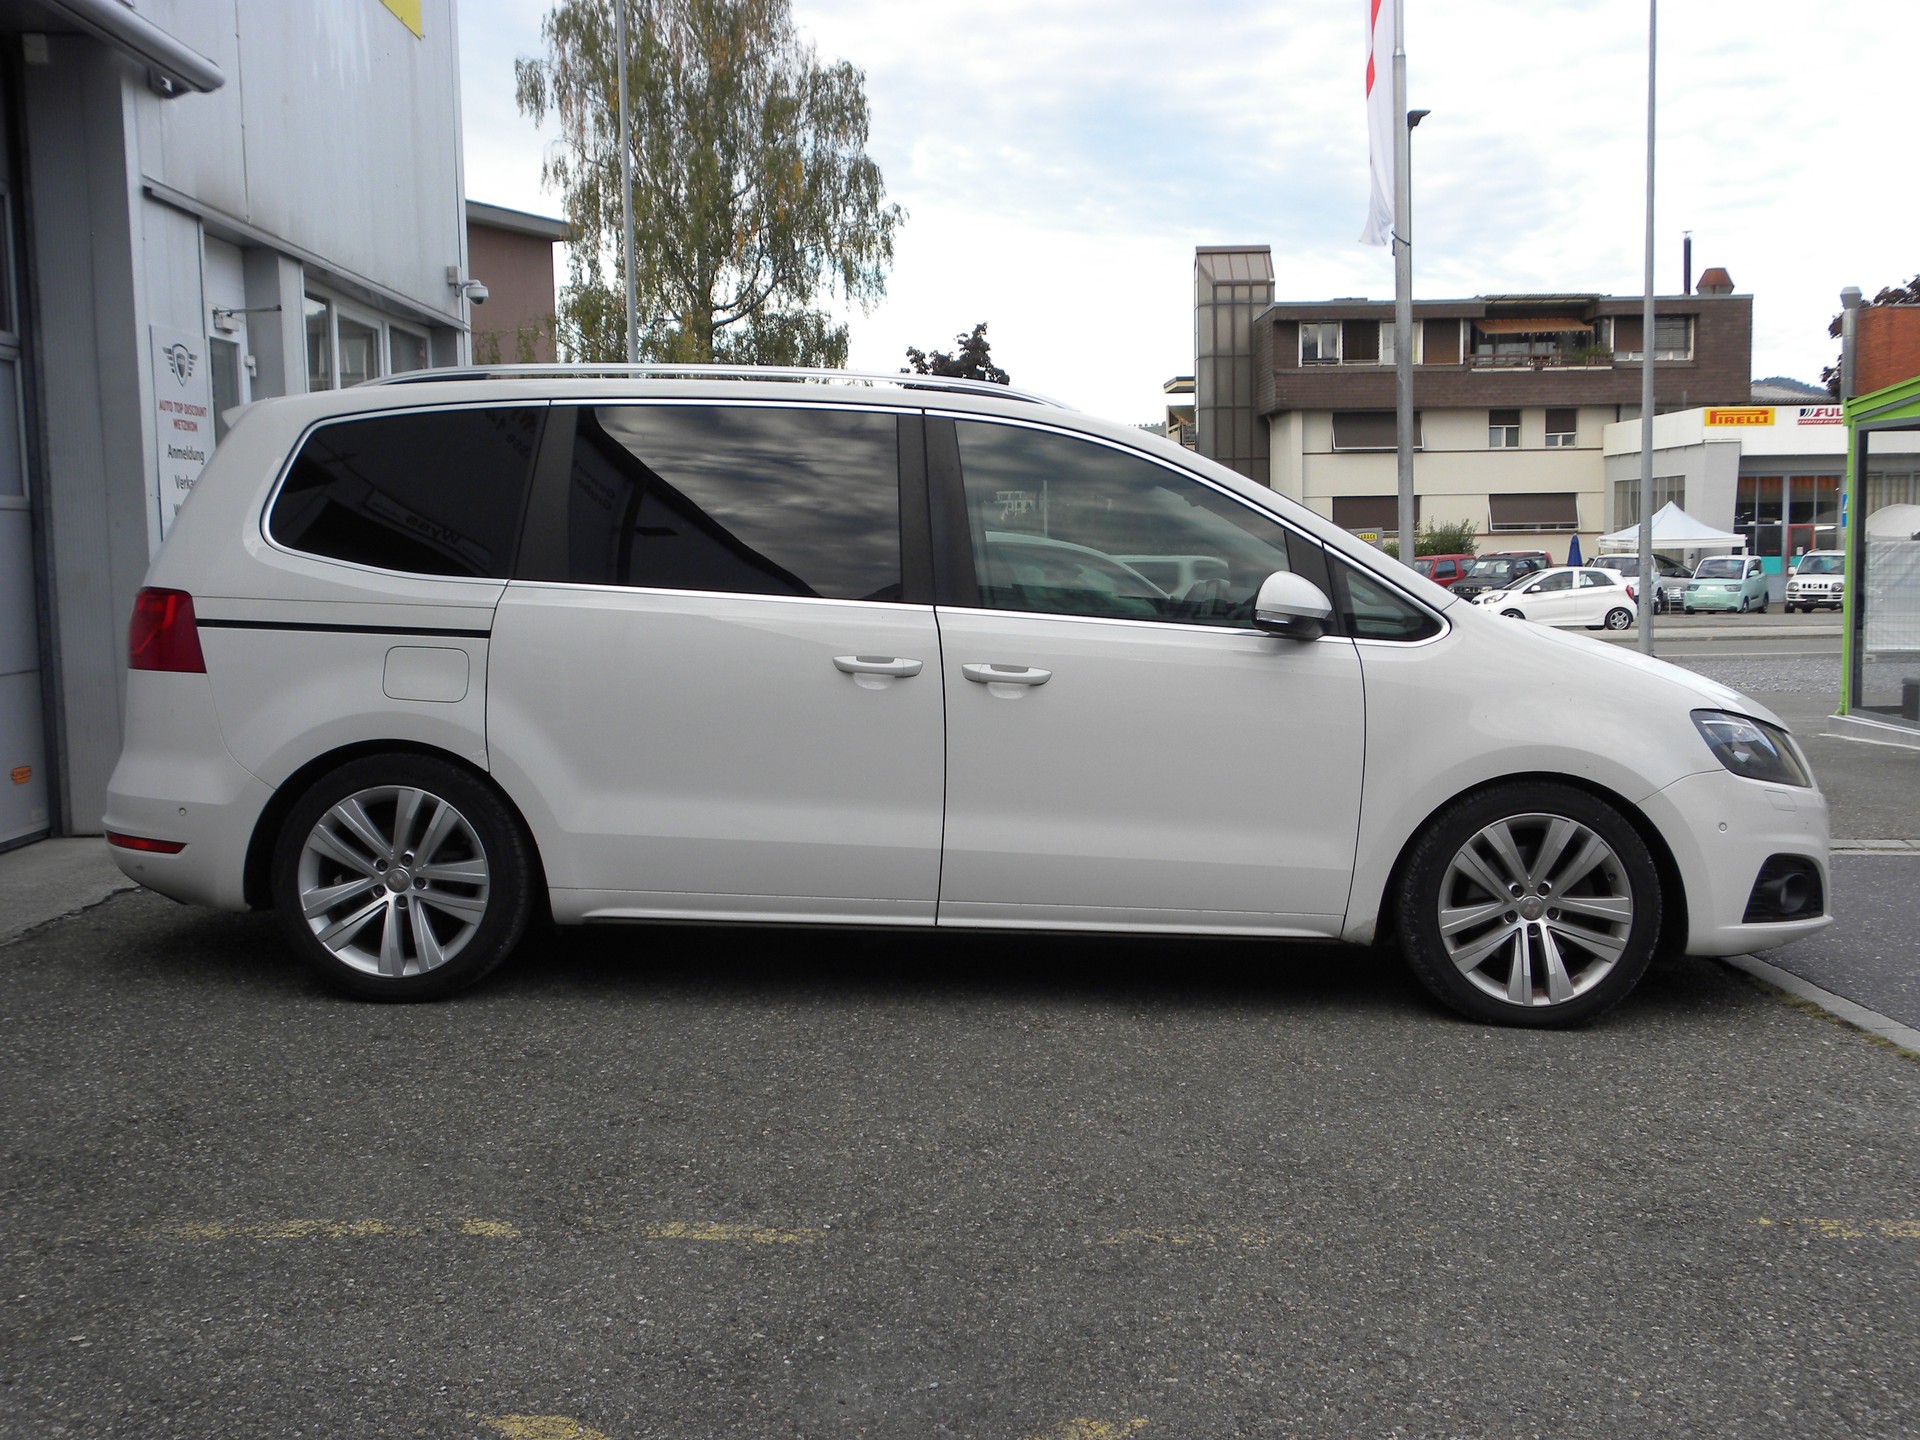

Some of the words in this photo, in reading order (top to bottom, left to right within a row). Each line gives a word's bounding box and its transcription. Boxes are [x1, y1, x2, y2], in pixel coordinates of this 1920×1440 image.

[159, 399, 173, 412] AUTO
[173, 401, 184, 414] TOP
[184, 403, 207, 417] DISCOUNT
[1813, 408, 1844, 417] FUL
[1710, 409, 1769, 424] PIRELLI
[167, 444, 205, 465] Anmeldung
[174, 474, 197, 490] Verka
